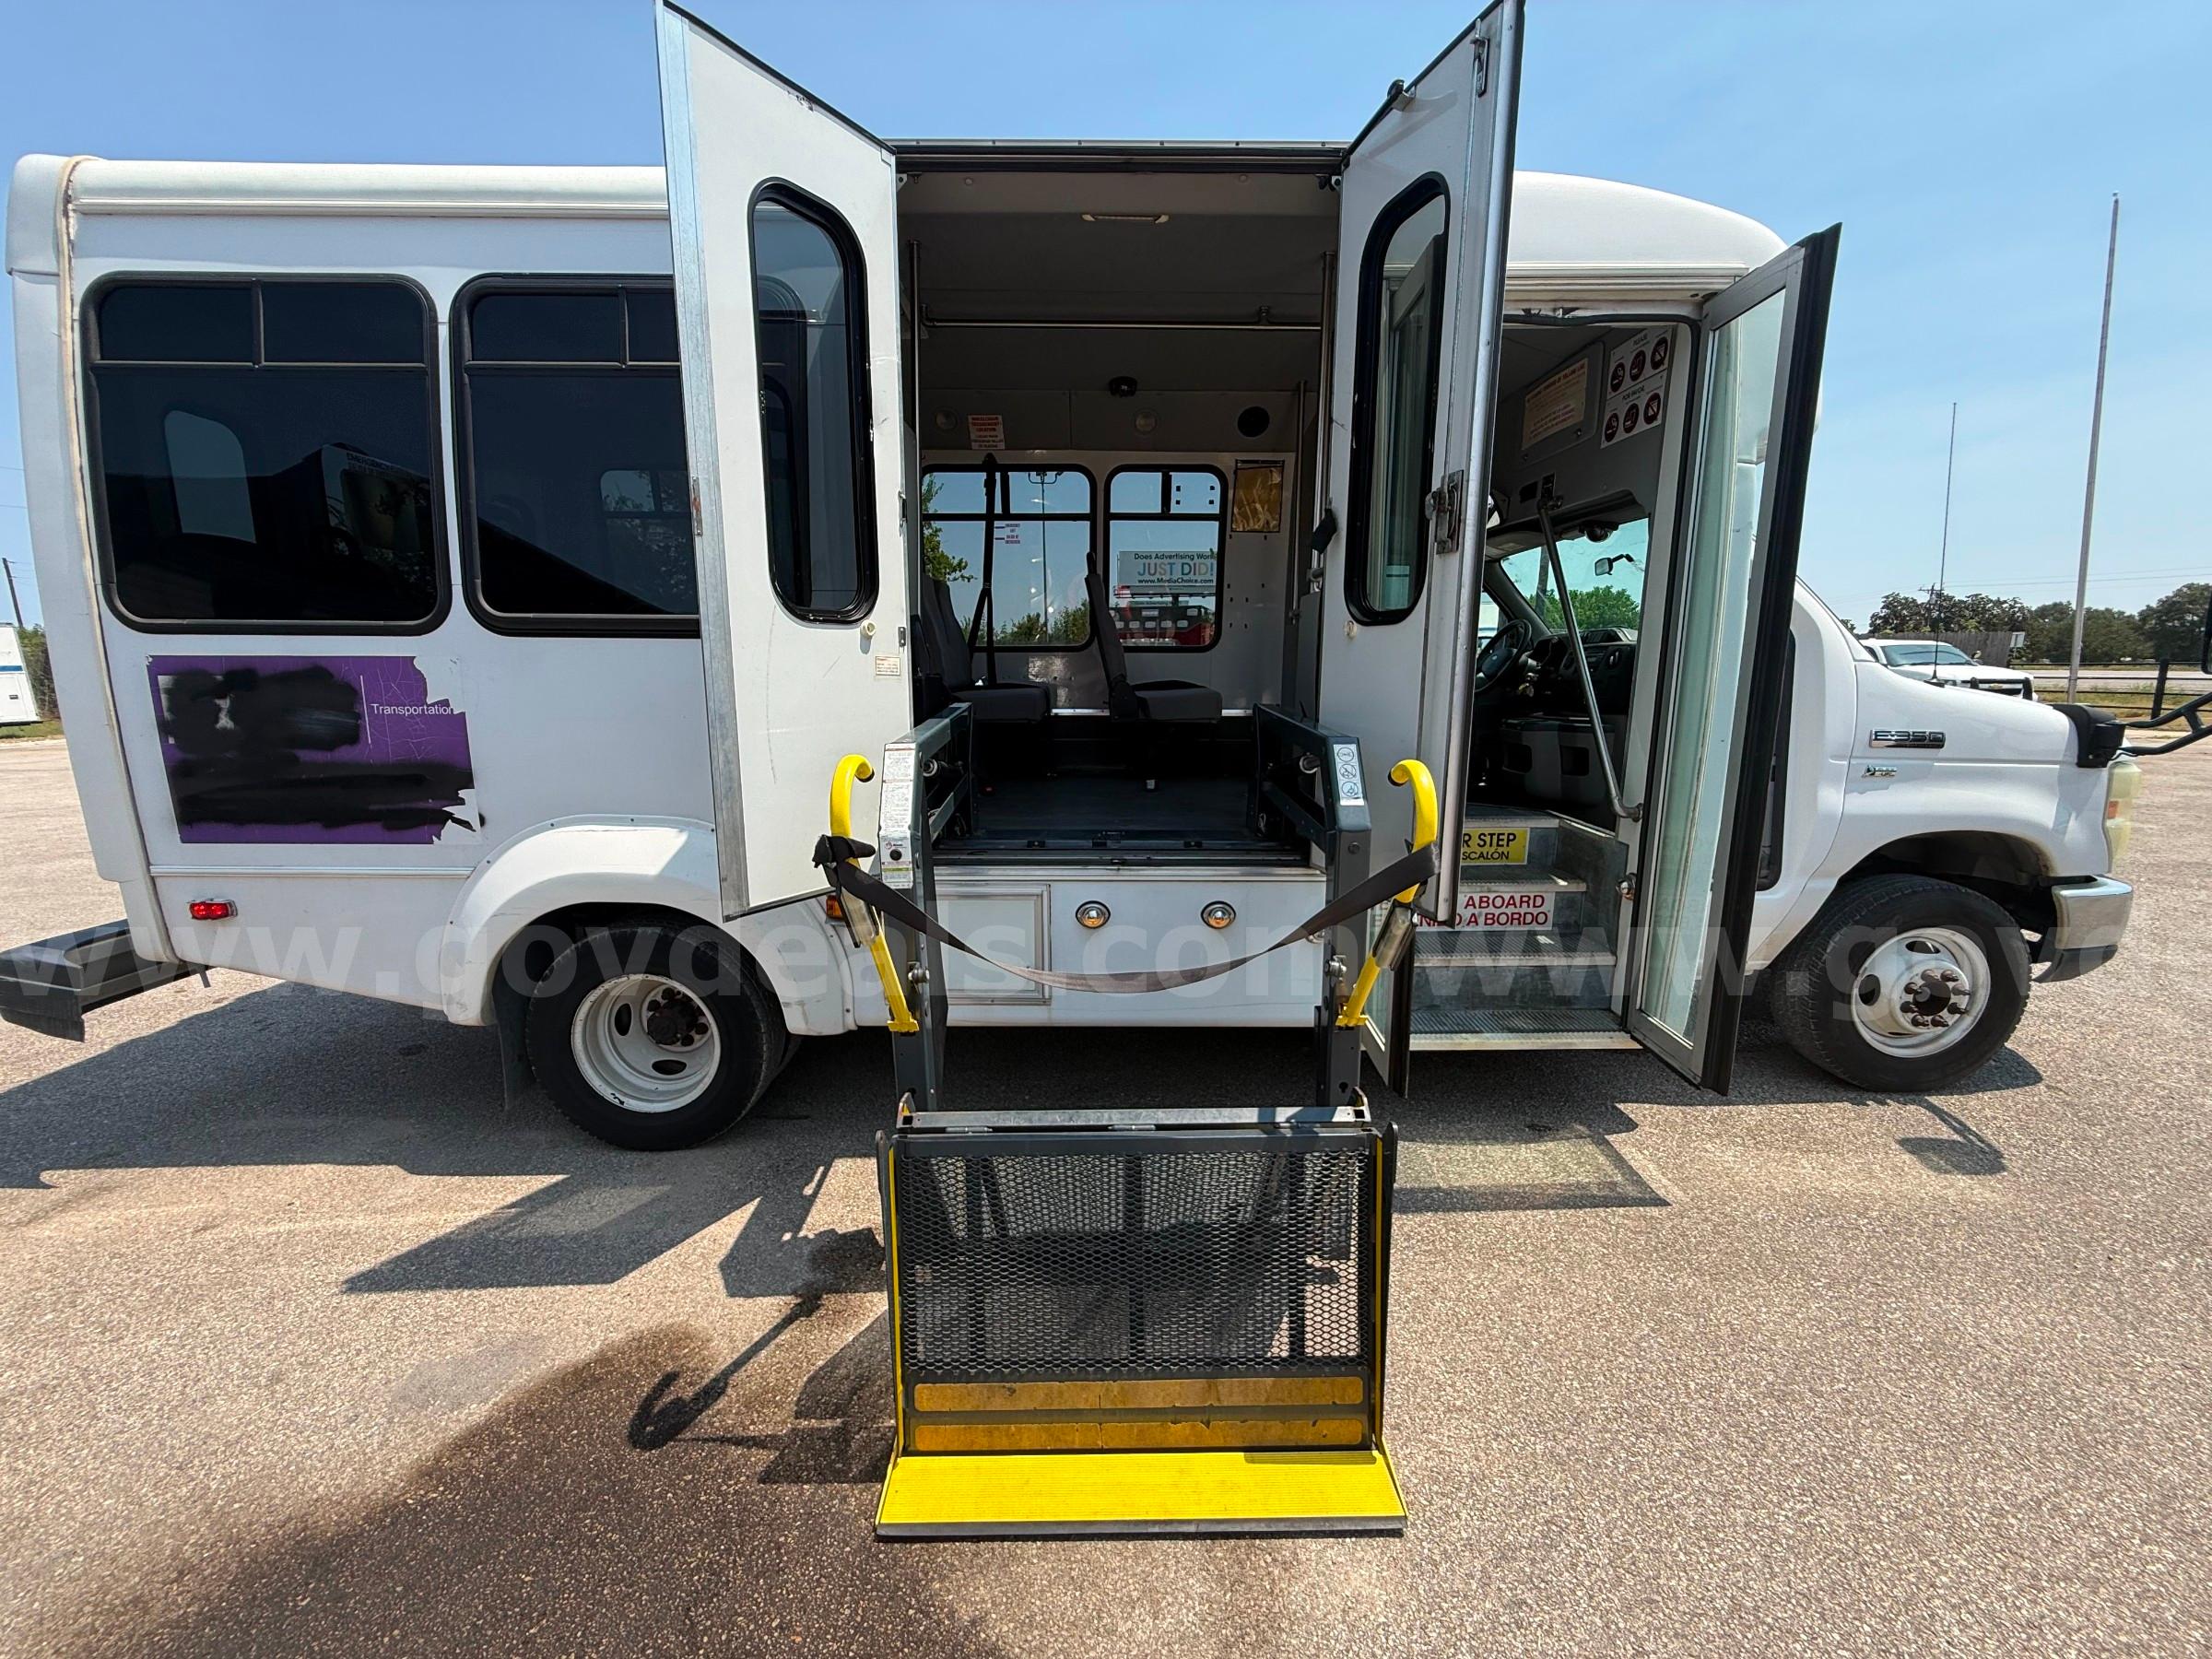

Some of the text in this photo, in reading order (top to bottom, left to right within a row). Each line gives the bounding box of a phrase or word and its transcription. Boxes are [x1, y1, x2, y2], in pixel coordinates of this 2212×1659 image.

[1154, 553, 1194, 561] Advertising
[1136, 562, 1214, 576] JUST DID!
[1477, 832, 1517, 848] STEP
[1462, 848, 1510, 861] SCALÓN
[1464, 894, 1545, 910] ABOARD
[1465, 912, 1479, 926] A
[1484, 912, 1548, 926] BORDO
